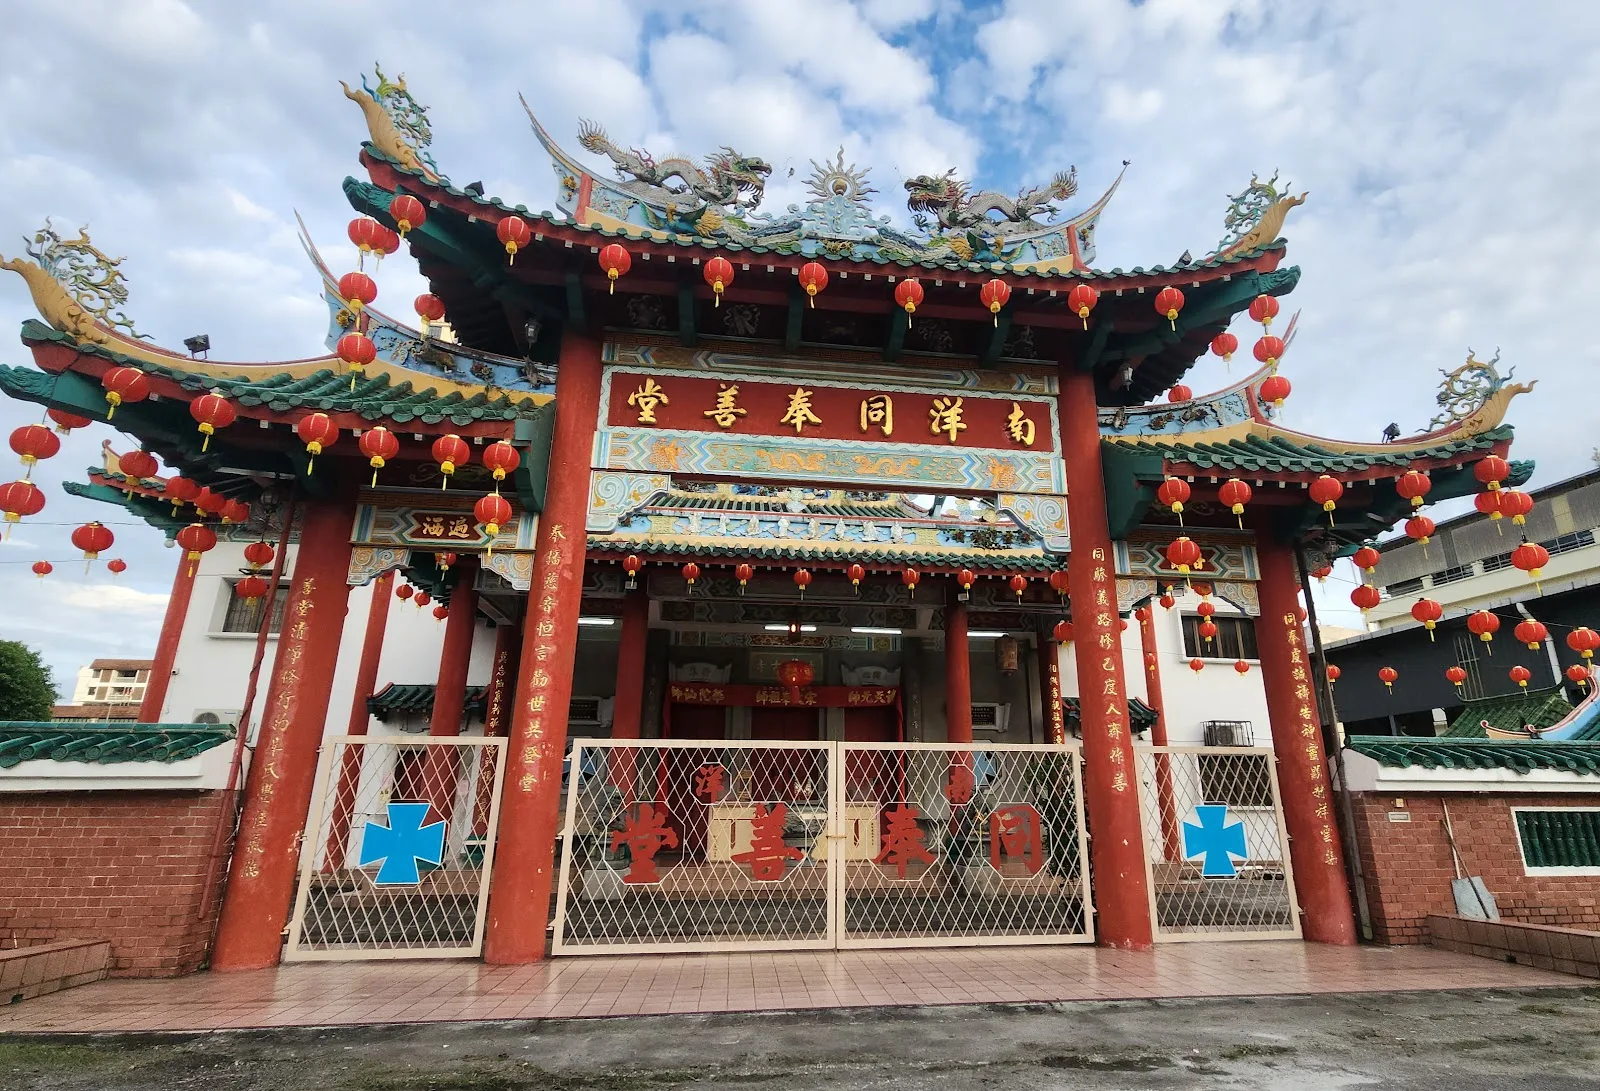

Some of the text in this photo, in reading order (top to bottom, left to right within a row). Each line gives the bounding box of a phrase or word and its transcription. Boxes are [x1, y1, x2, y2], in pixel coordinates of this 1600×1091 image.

[627, 376, 1037, 447] 南洋同奉善堂
